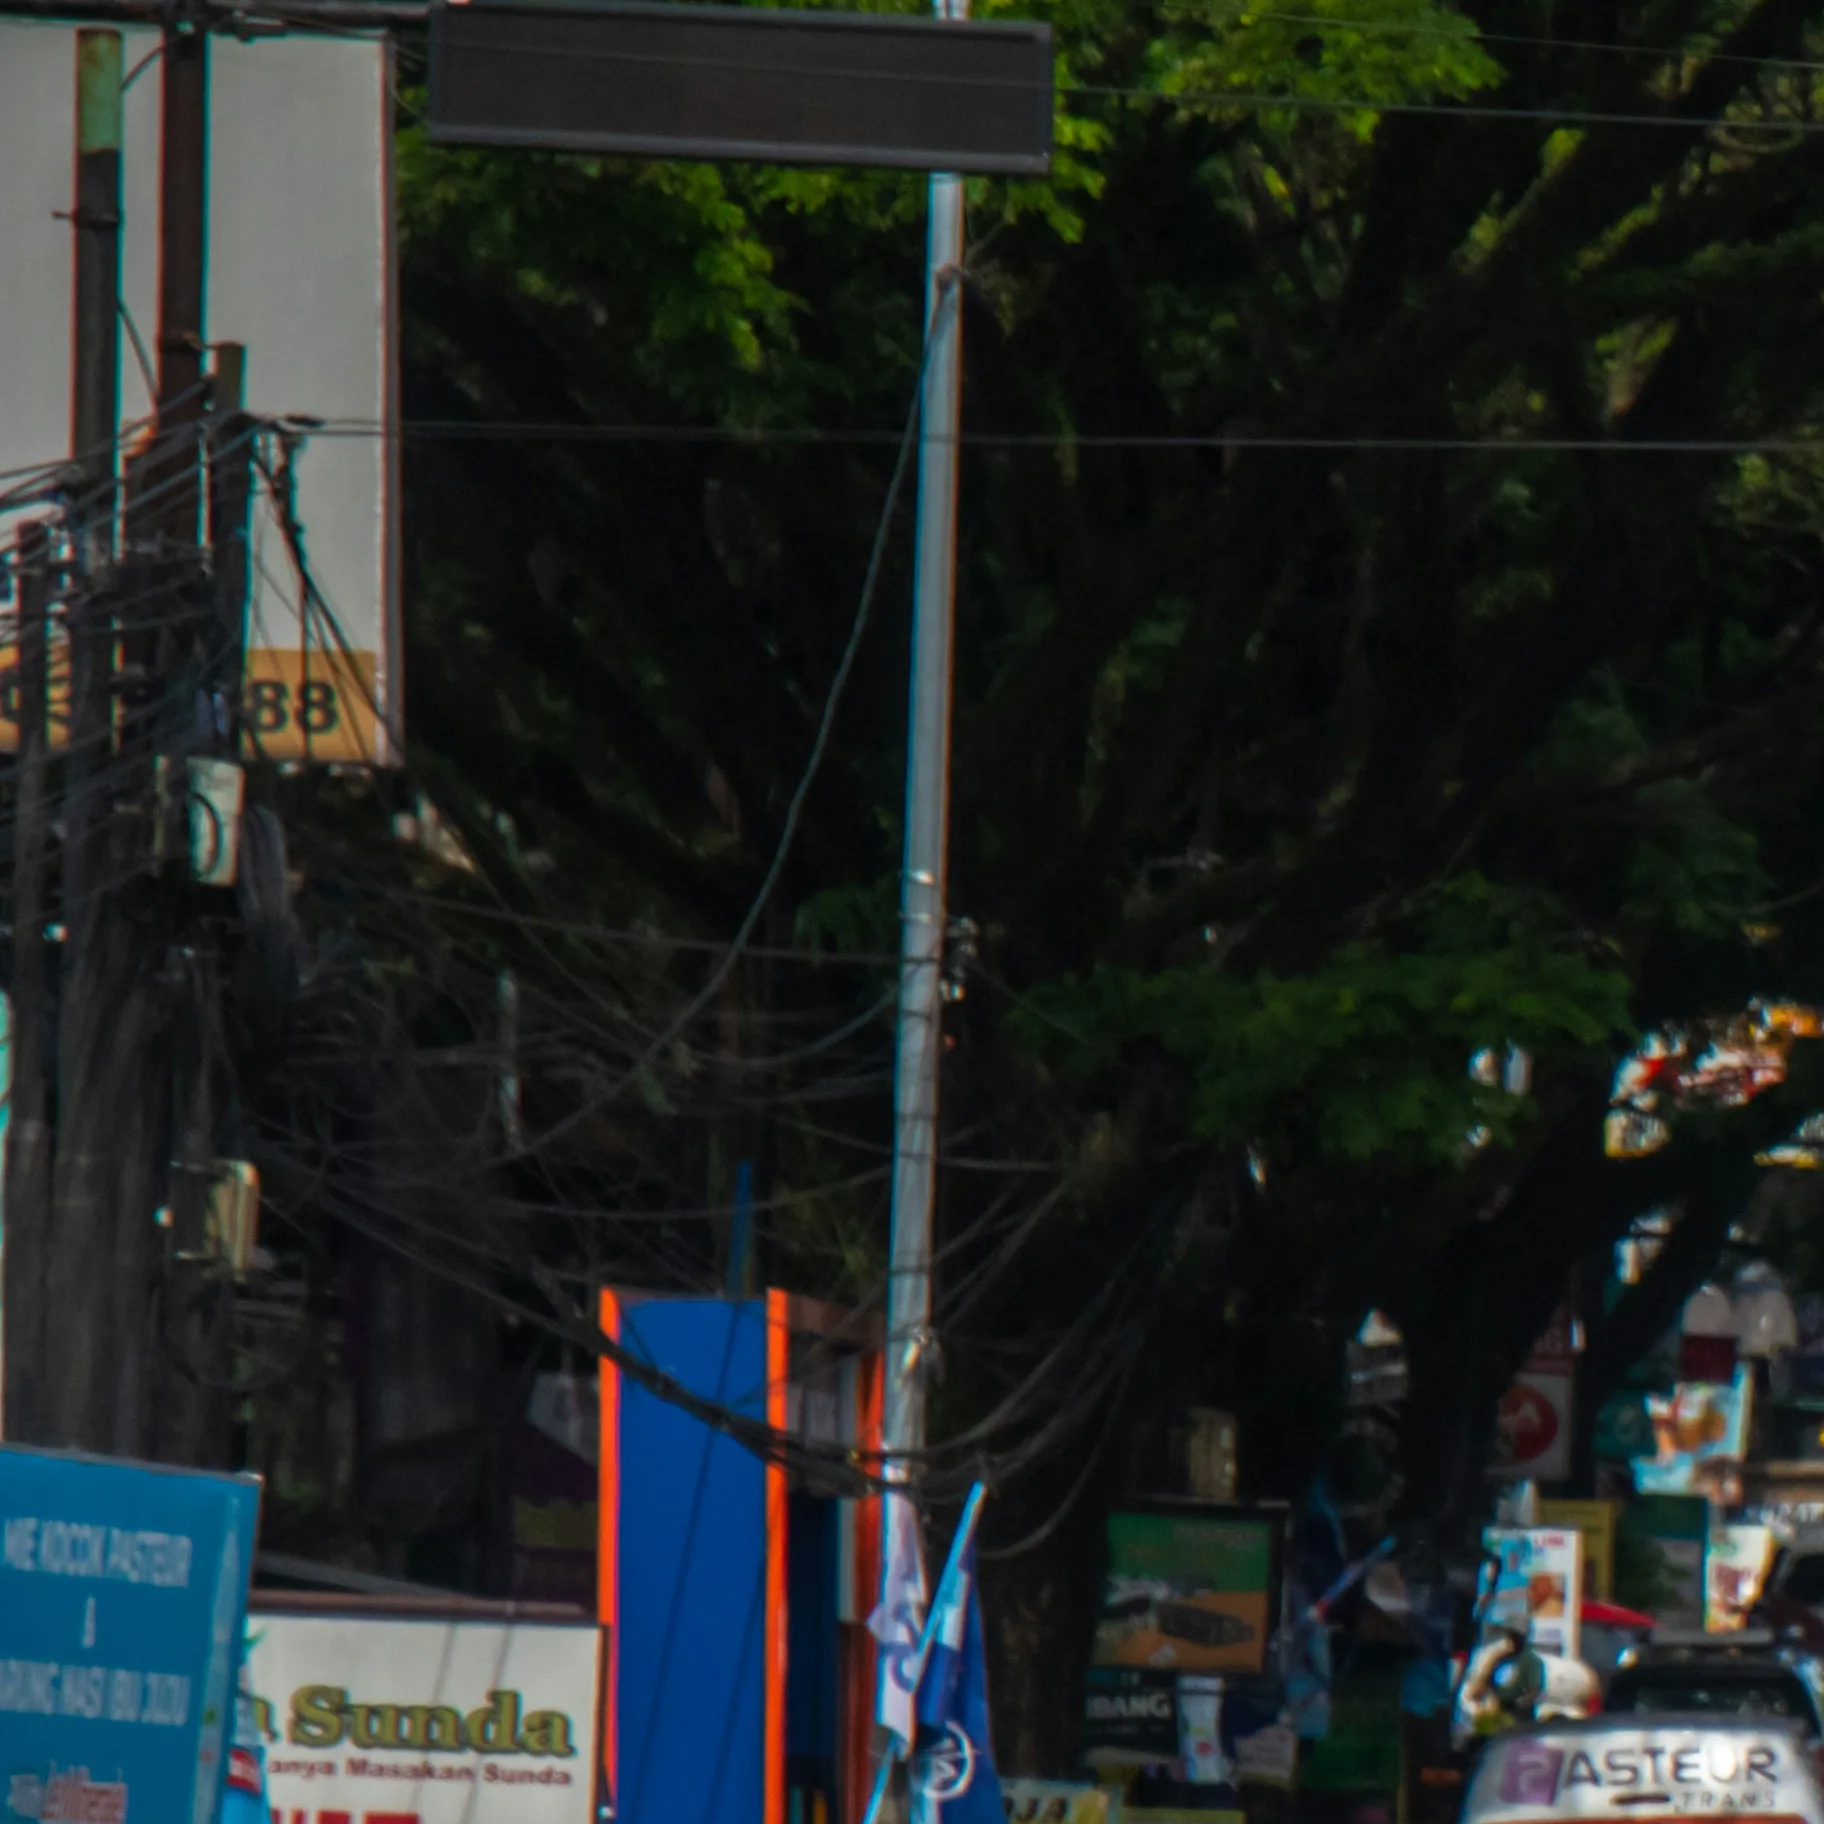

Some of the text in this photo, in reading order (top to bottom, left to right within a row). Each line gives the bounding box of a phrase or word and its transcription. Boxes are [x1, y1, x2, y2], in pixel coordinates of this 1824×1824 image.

[288, 1684, 577, 1757] Sunda
[346, 1758, 475, 1783] Masakan
[482, 1763, 572, 1785] Sunda
